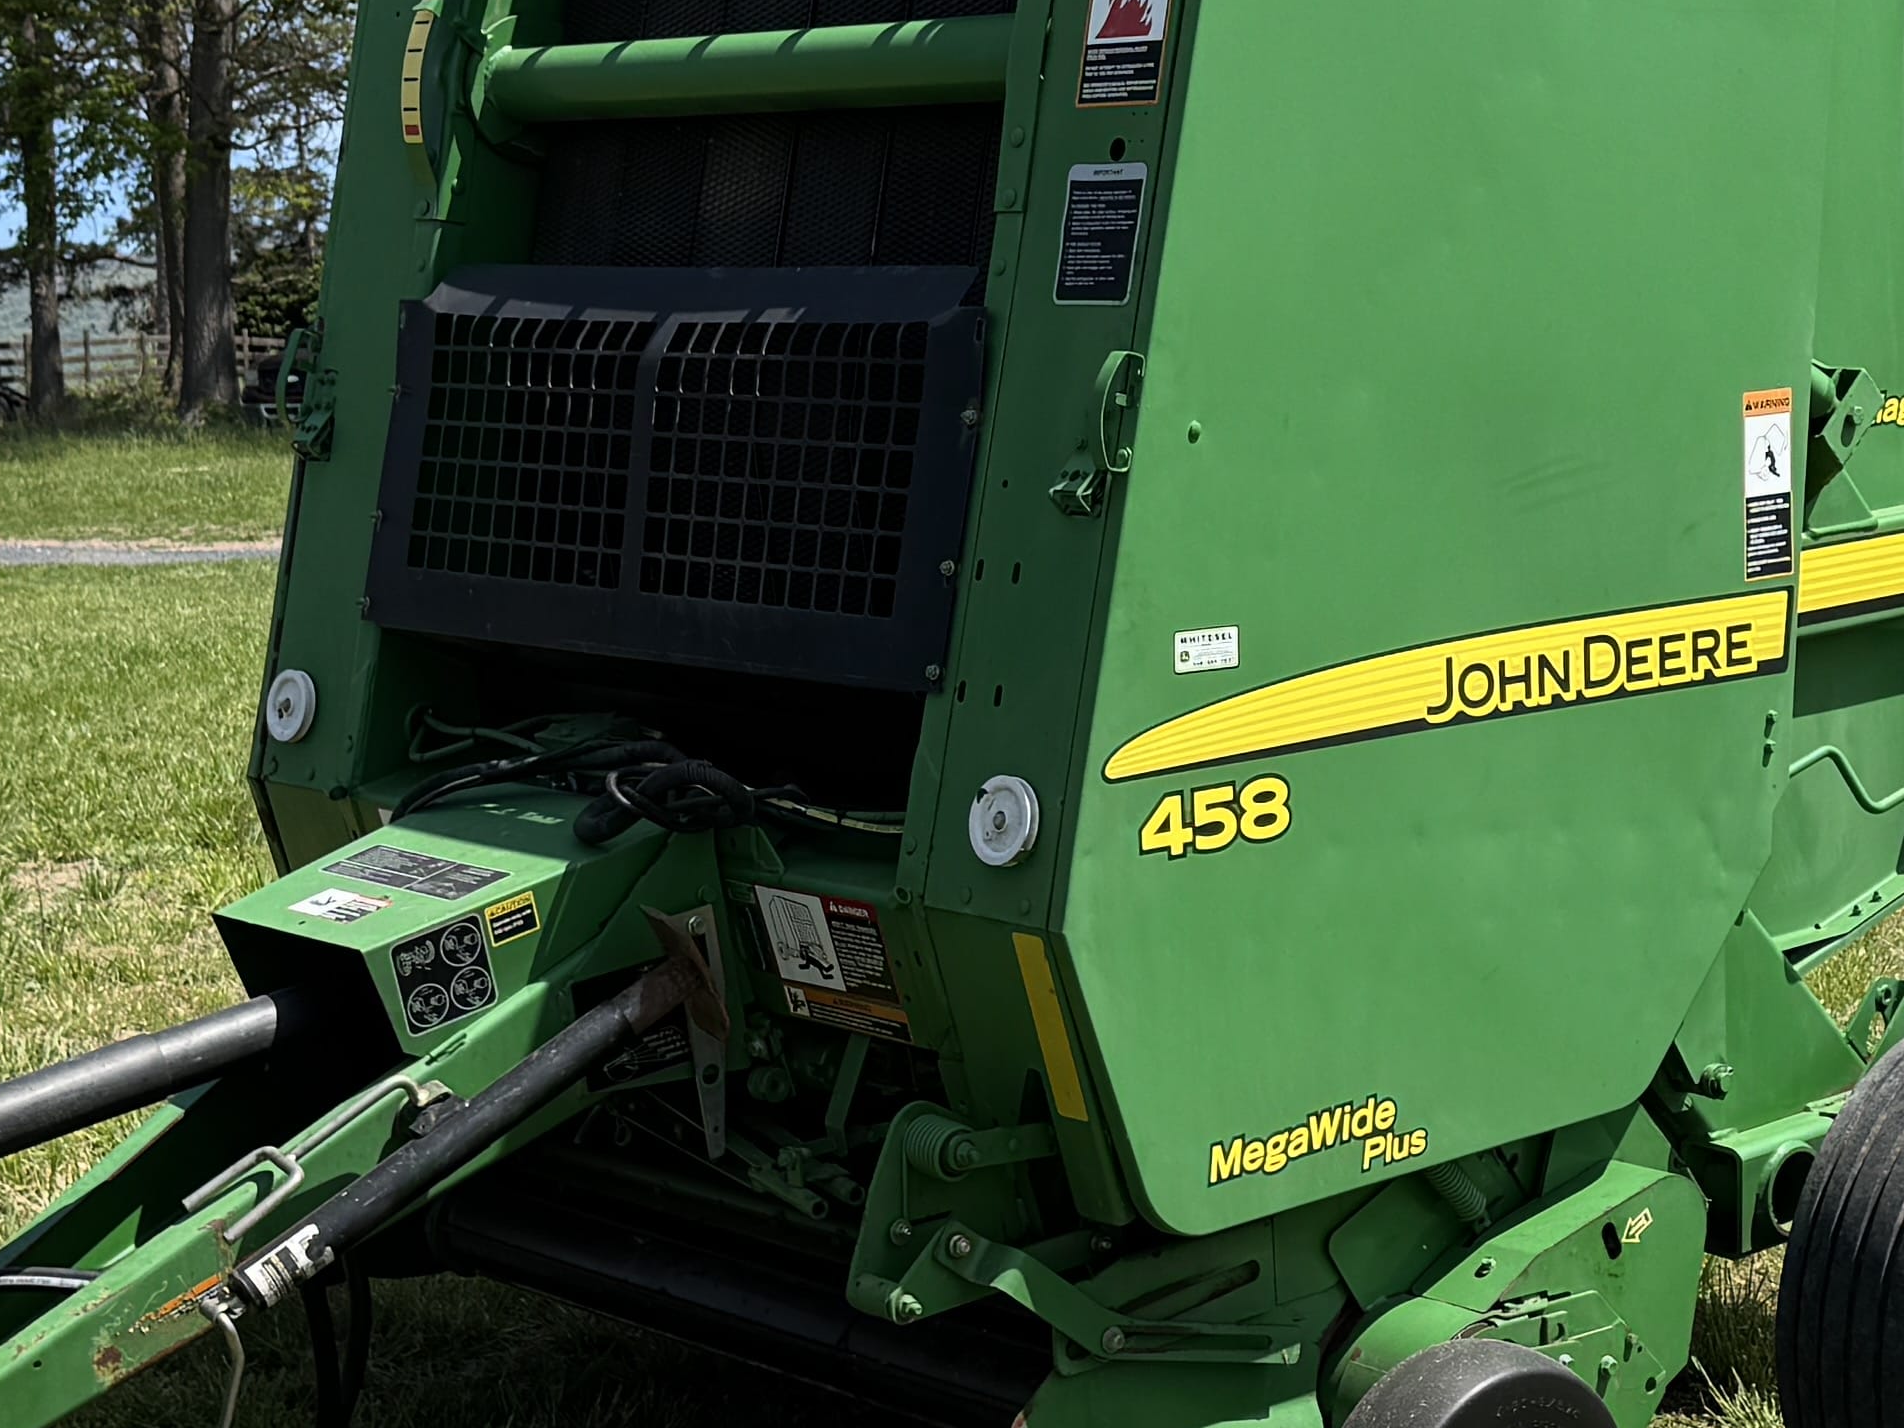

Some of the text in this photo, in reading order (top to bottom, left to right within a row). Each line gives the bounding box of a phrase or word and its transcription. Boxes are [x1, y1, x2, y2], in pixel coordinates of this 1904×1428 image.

[1752, 397, 1790, 411] WARNING
[1426, 622, 1753, 717] JOHN DEERE
[1141, 775, 1291, 859] 458
[1208, 1094, 1397, 1187] MegaWide
[1361, 1128, 1428, 1172] Plus
